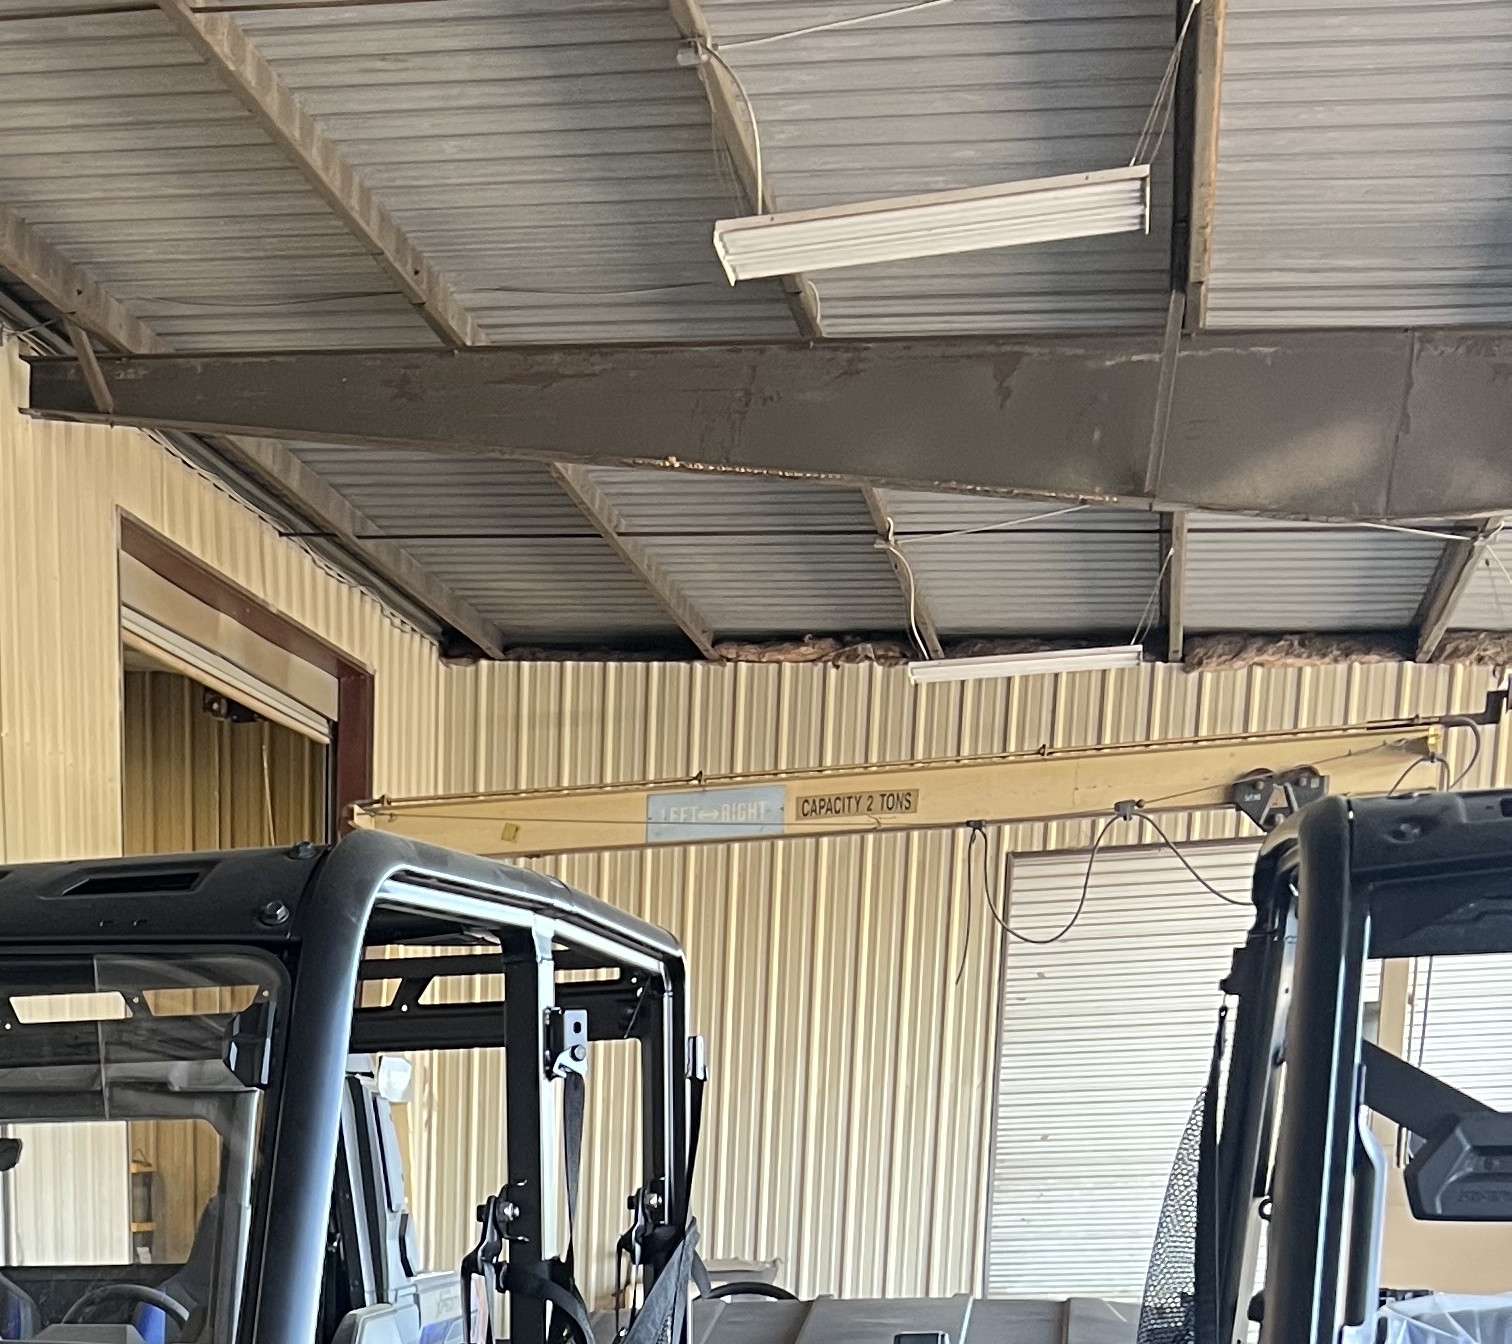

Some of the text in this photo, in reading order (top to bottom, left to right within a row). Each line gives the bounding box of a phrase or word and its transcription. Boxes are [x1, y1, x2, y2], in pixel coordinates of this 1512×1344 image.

[661, 802, 767, 822] LEFT RIGHT
[801, 792, 912, 817] CAPACITY 2 TONS
